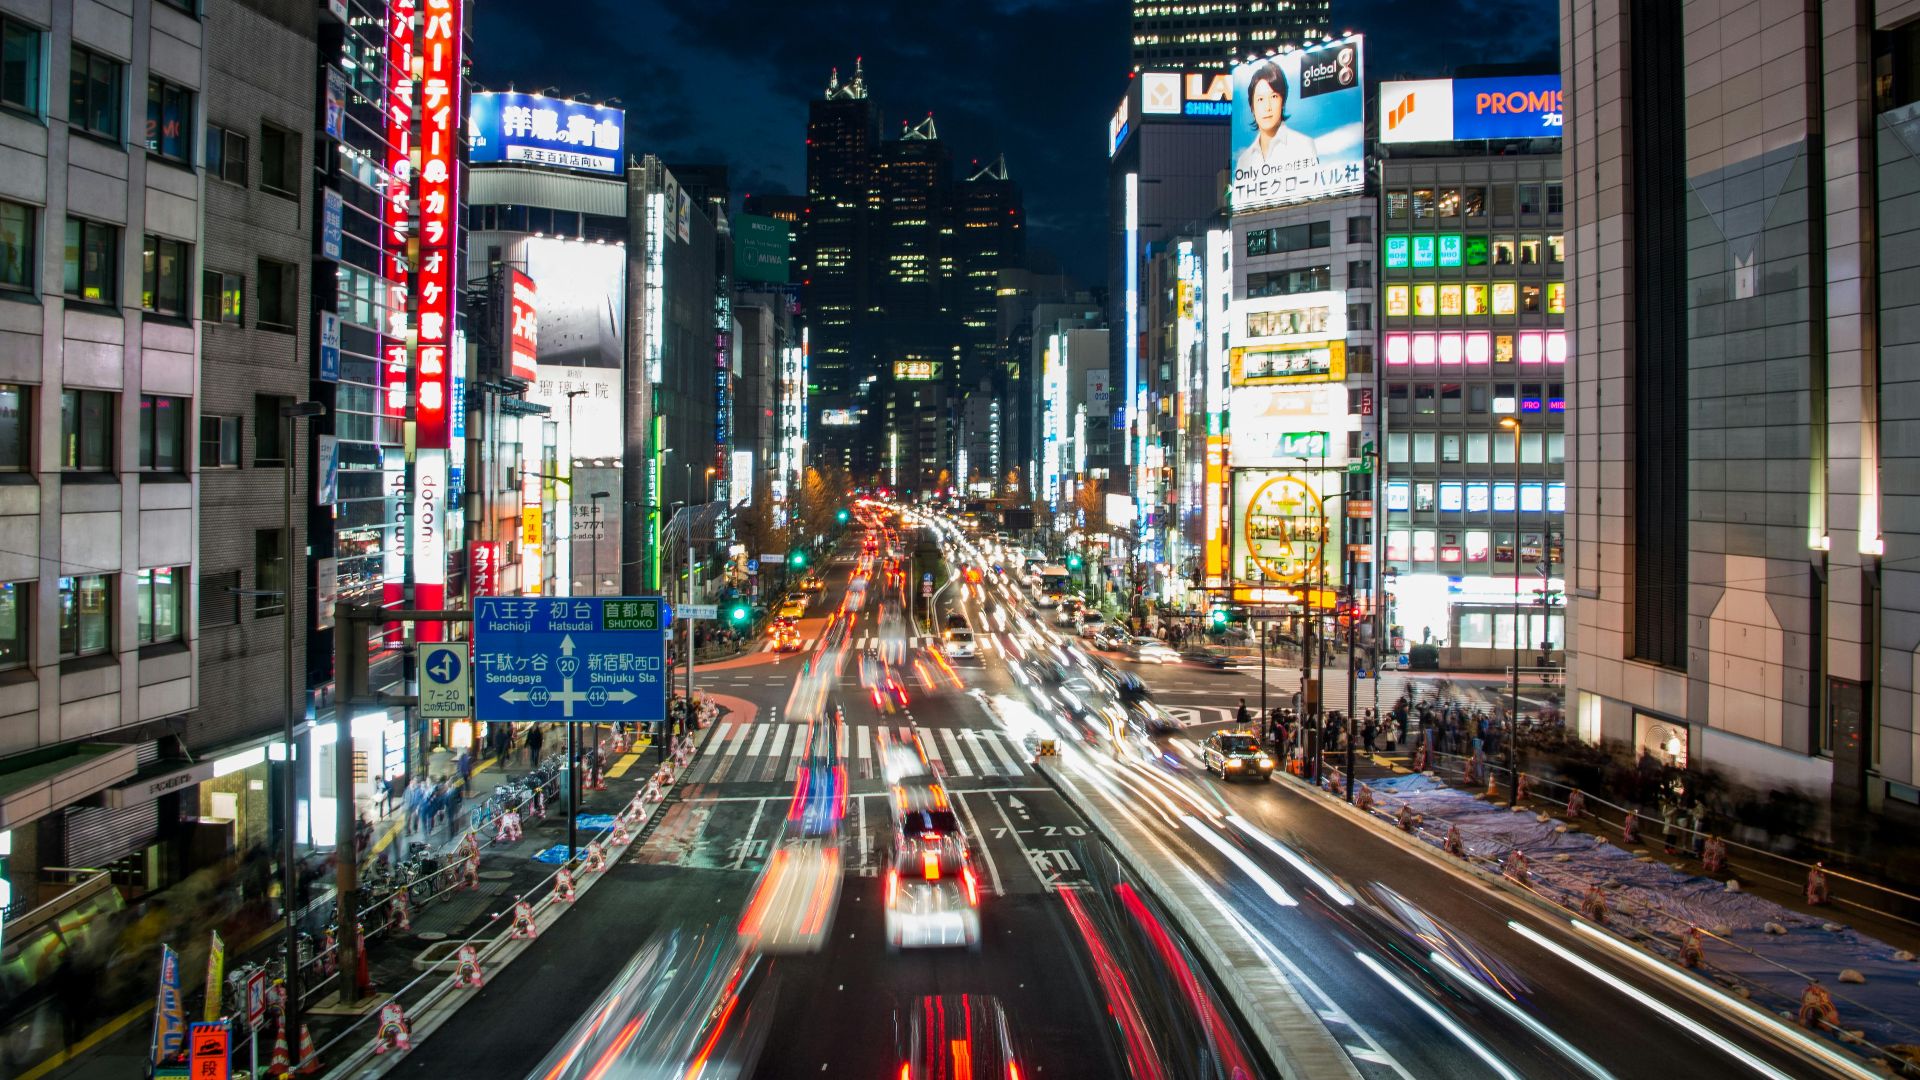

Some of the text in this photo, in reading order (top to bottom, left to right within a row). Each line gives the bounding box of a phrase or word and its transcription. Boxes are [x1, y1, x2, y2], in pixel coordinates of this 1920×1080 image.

[1304, 60, 1337, 87] global
[503, 106, 620, 150] 洋服の青山
[522, 148, 603, 167] 京王百貨店向い
[1235, 166, 1259, 181] Only
[1261, 164, 1283, 175] One
[1235, 163, 1360, 198] THEグローバル社
[759, 254, 782, 264] MIWA
[1524, 401, 1540, 409] PRO
[422, 475, 436, 557] docomo
[480, 601, 592, 619] 八王子 初台
[605, 603, 655, 618] 首都高
[489, 621, 593, 632] Hachioji Hatsudai
[608, 620, 653, 628] SHUTOKO
[561, 660, 575, 672] 20
[587, 653, 660, 671] 新宿駅西口
[486, 673, 542, 684] Sendagaya
[590, 673, 658, 684] Shinjuku Sta.
[531, 691, 547, 701] 414
[589, 691, 605, 701] 414
[424, 701, 466, 712] この先50m
[202, 1061, 217, 1080] 段
